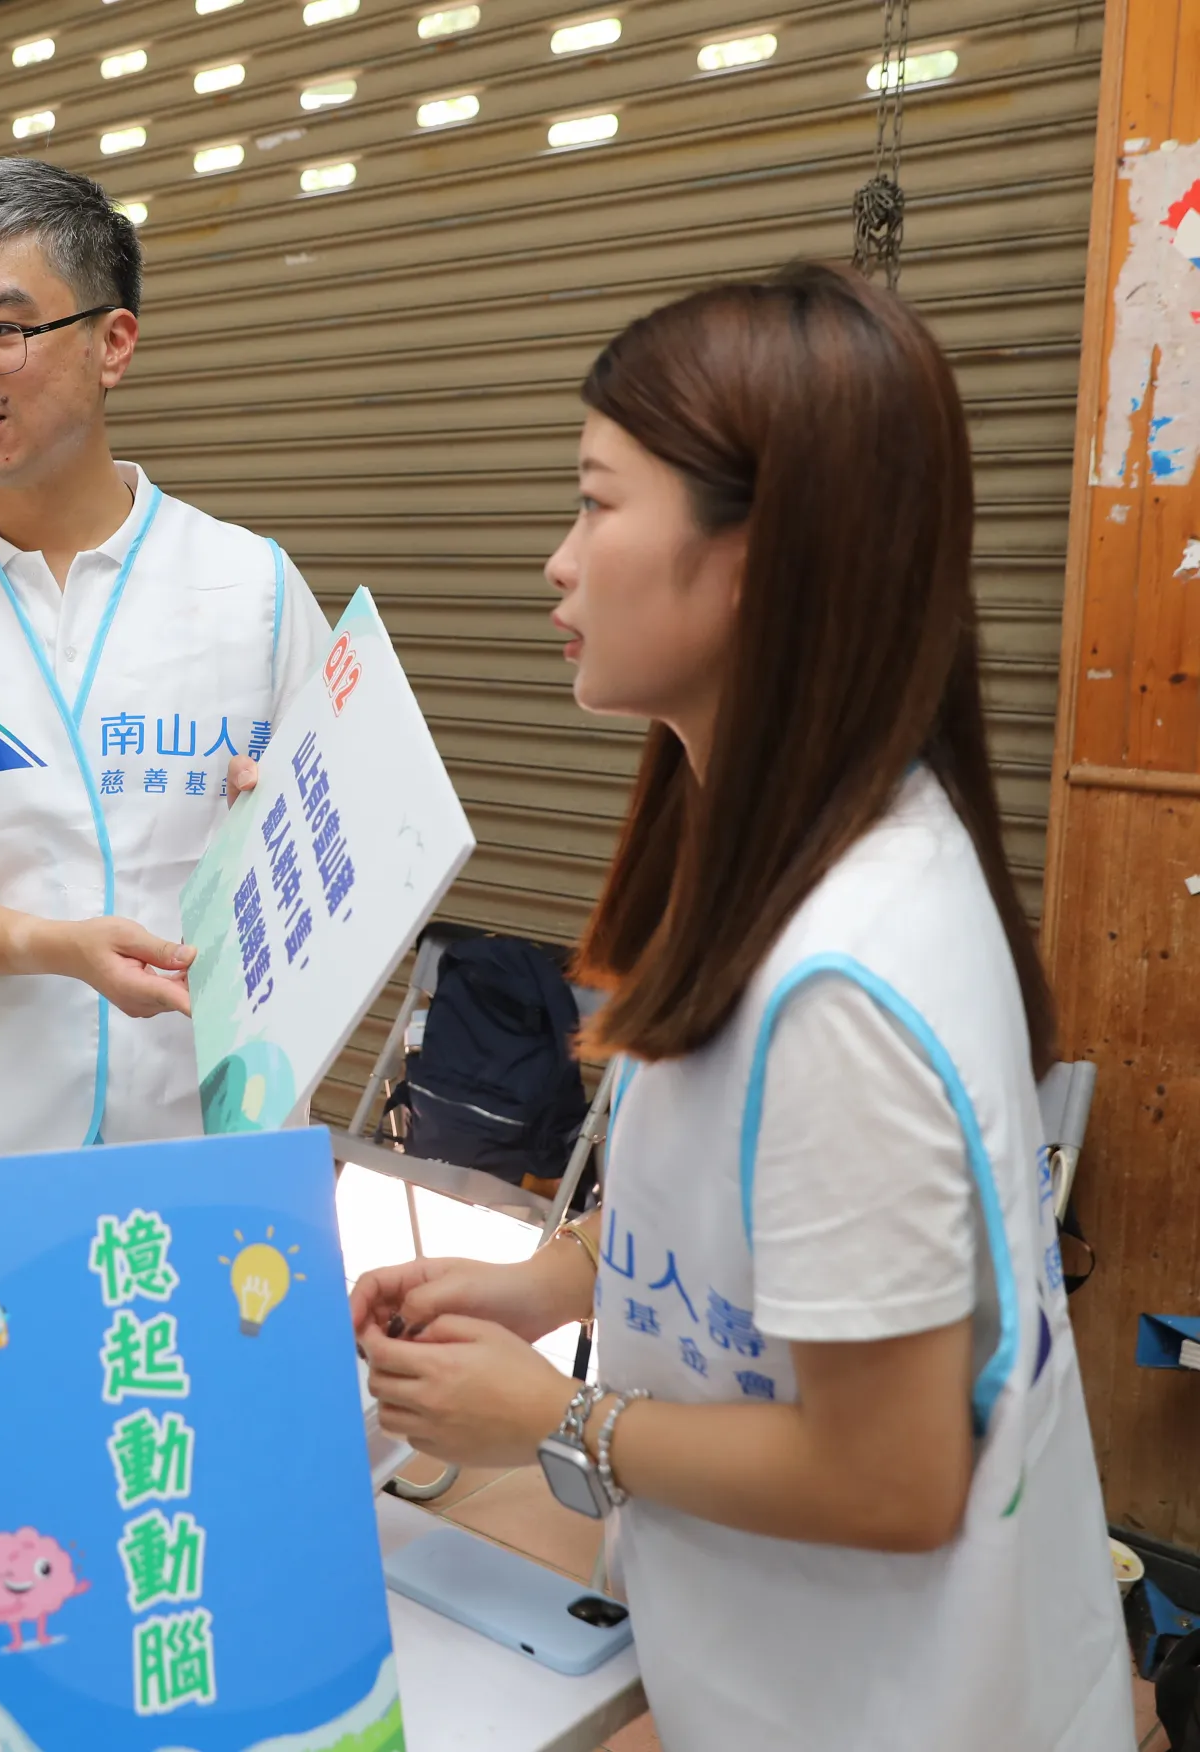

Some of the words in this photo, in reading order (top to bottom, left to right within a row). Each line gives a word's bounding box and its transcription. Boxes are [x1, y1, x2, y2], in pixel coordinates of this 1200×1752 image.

[323, 631, 362, 718] Q12
[100, 711, 272, 762] 南山人壽
[91, 1213, 213, 1709] 憶起動動腦
